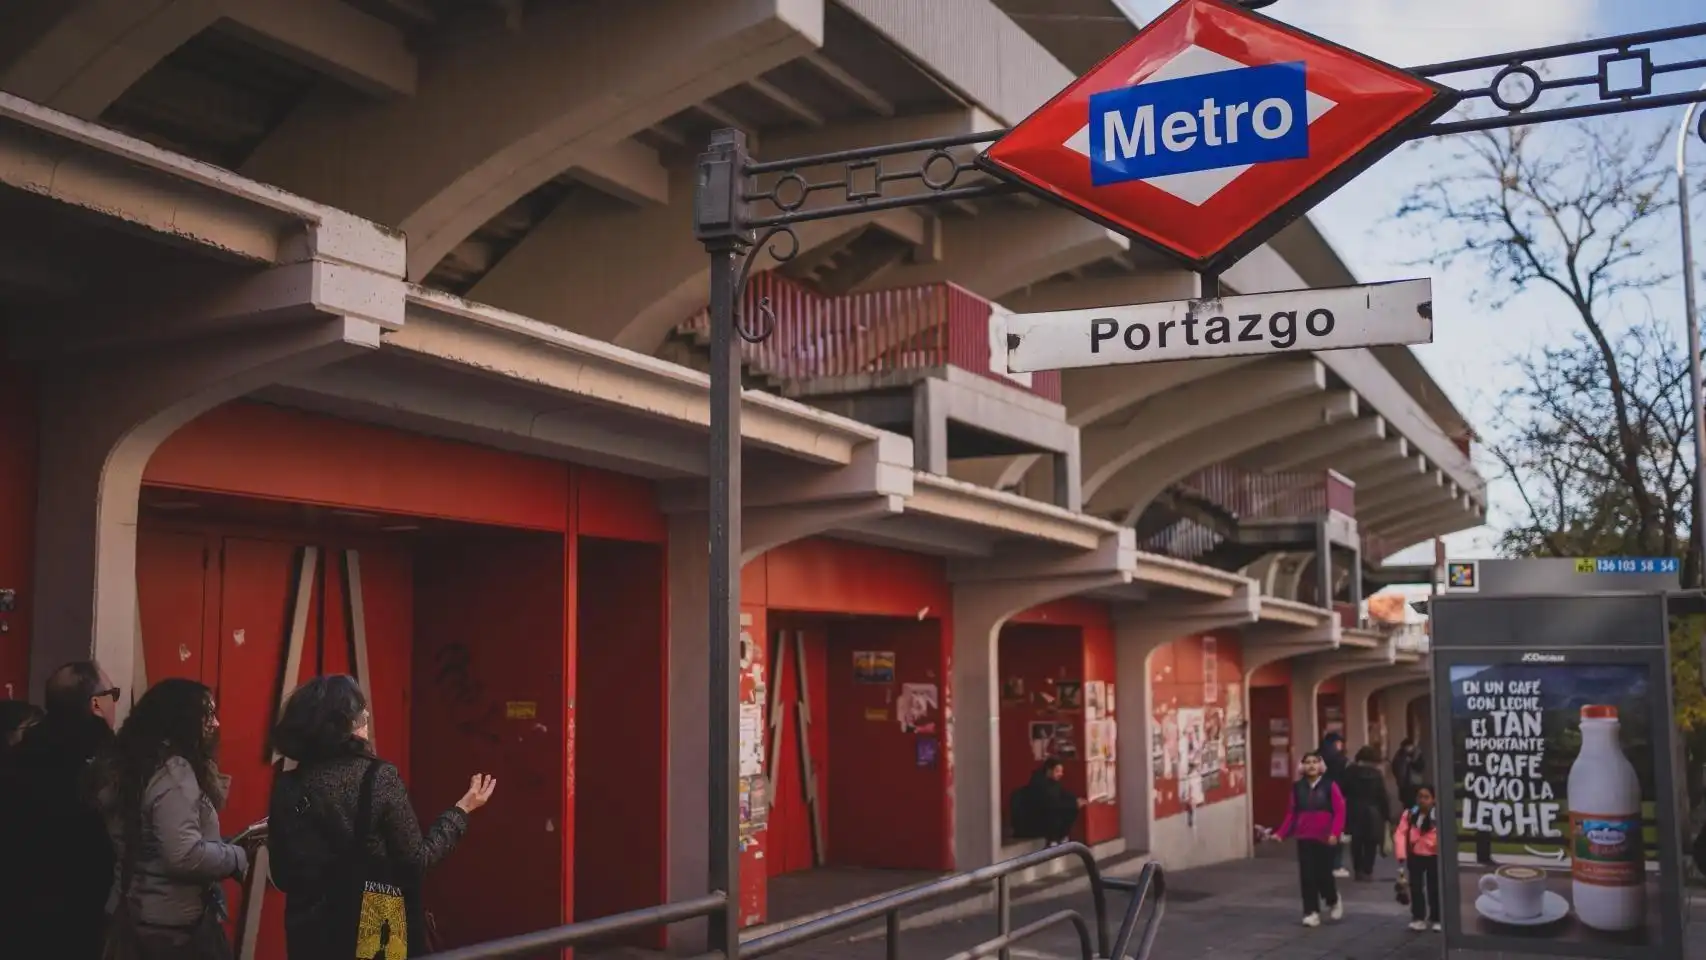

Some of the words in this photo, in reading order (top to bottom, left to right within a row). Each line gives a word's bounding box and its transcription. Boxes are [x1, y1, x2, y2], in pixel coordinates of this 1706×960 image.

[1103, 97, 1293, 162] Metro
[1091, 308, 1335, 354] Portazgo
[1597, 559, 1616, 572] 136
[1618, 559, 1637, 572] 103
[1641, 560, 1654, 573] 58
[1661, 559, 1675, 573] 54
[1462, 680, 1480, 695] EN
[1484, 680, 1504, 695] UN
[1467, 696, 1496, 710] CON
[1471, 718, 1487, 737] ES
[1489, 711, 1542, 737] TAN
[1465, 737, 1545, 752] IMPORTANTE
[1467, 752, 1483, 766] EL
[1486, 751, 1544, 778] CAFÉ
[1464, 772, 1524, 802] COMO
[1528, 781, 1554, 800] LA
[1462, 797, 1562, 837] LECHE
